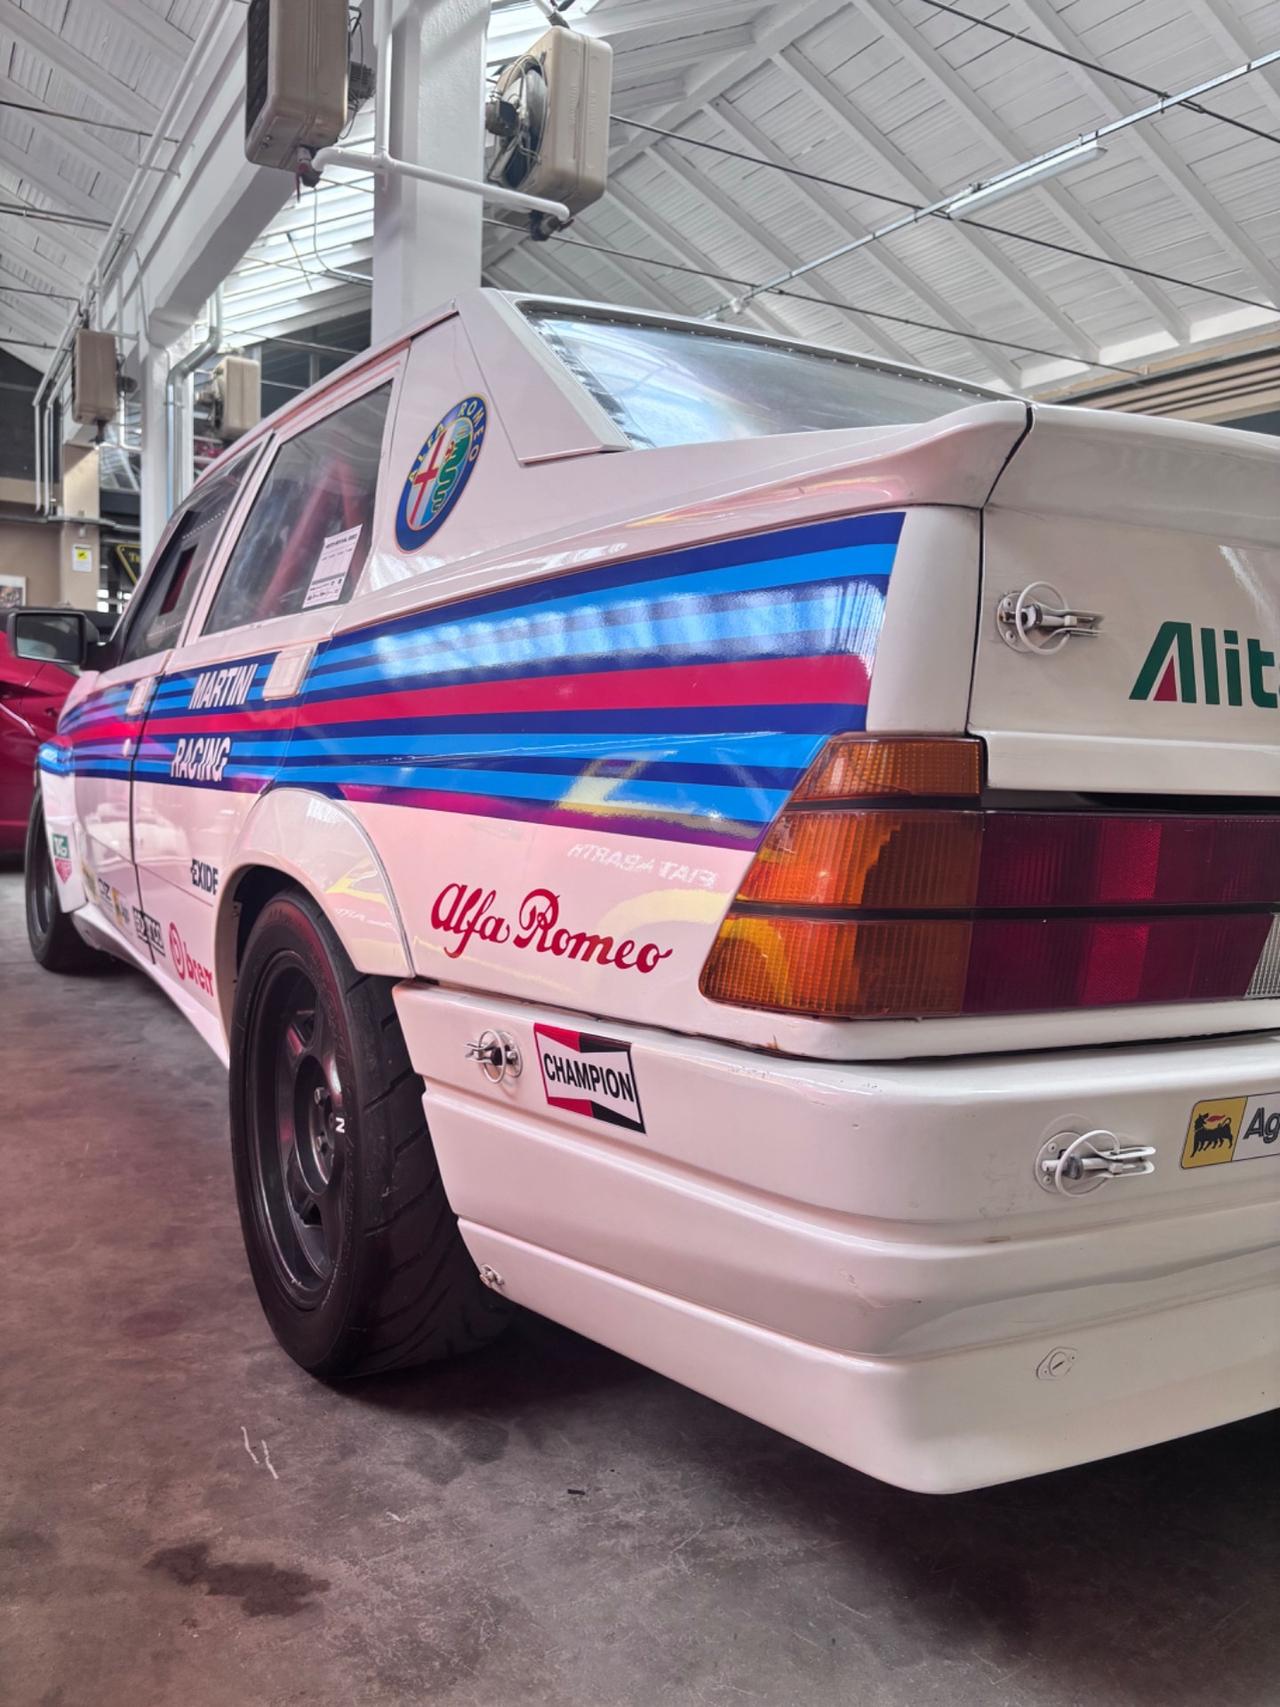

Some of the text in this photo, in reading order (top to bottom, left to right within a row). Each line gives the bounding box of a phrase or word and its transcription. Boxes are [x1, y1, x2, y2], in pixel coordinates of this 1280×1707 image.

[457, 399, 485, 462] ROMEO
[188, 663, 258, 710] MARTINI
[1128, 620, 1280, 708] Alit
[170, 727, 232, 782] RACING
[190, 858, 219, 896] EXIDE
[430, 883, 673, 973] Alfa Romeo
[543, 1053, 635, 1102] CHAMPION
